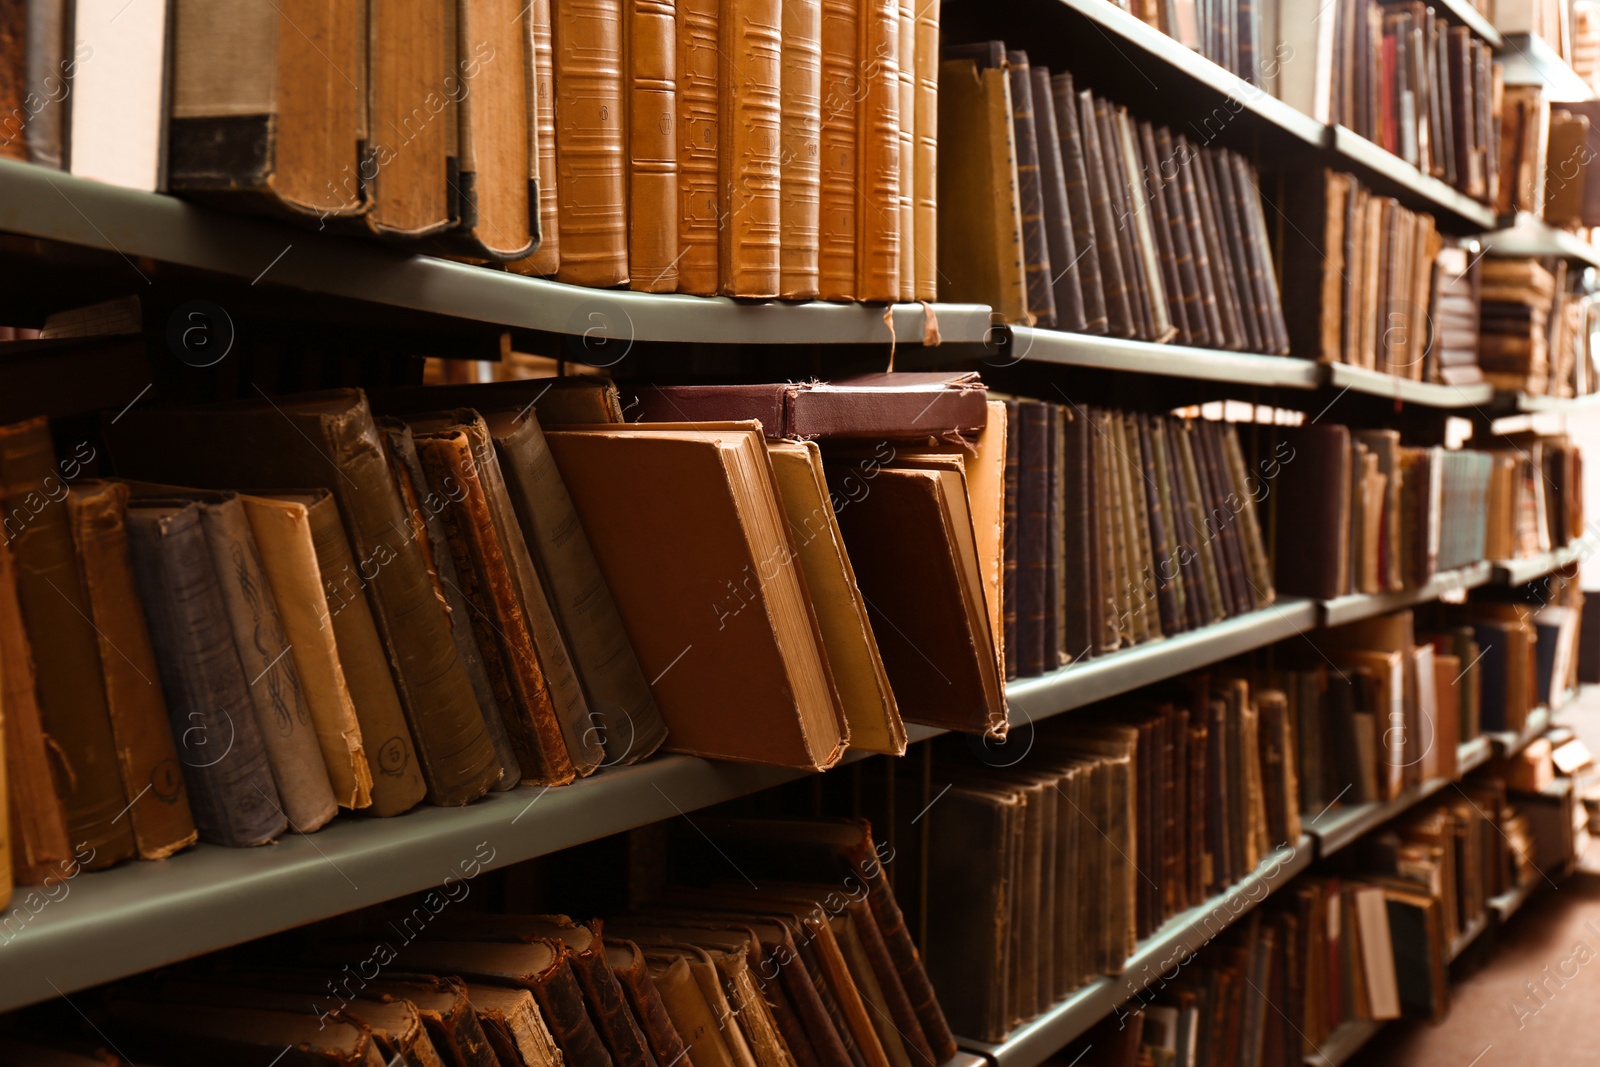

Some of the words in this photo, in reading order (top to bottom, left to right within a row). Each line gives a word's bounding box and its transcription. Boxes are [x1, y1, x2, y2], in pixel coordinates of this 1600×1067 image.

[538, 82, 548, 99] 4
[599, 105, 609, 121] 6
[703, 127, 712, 143] 9
[389, 744, 401, 763] 5
